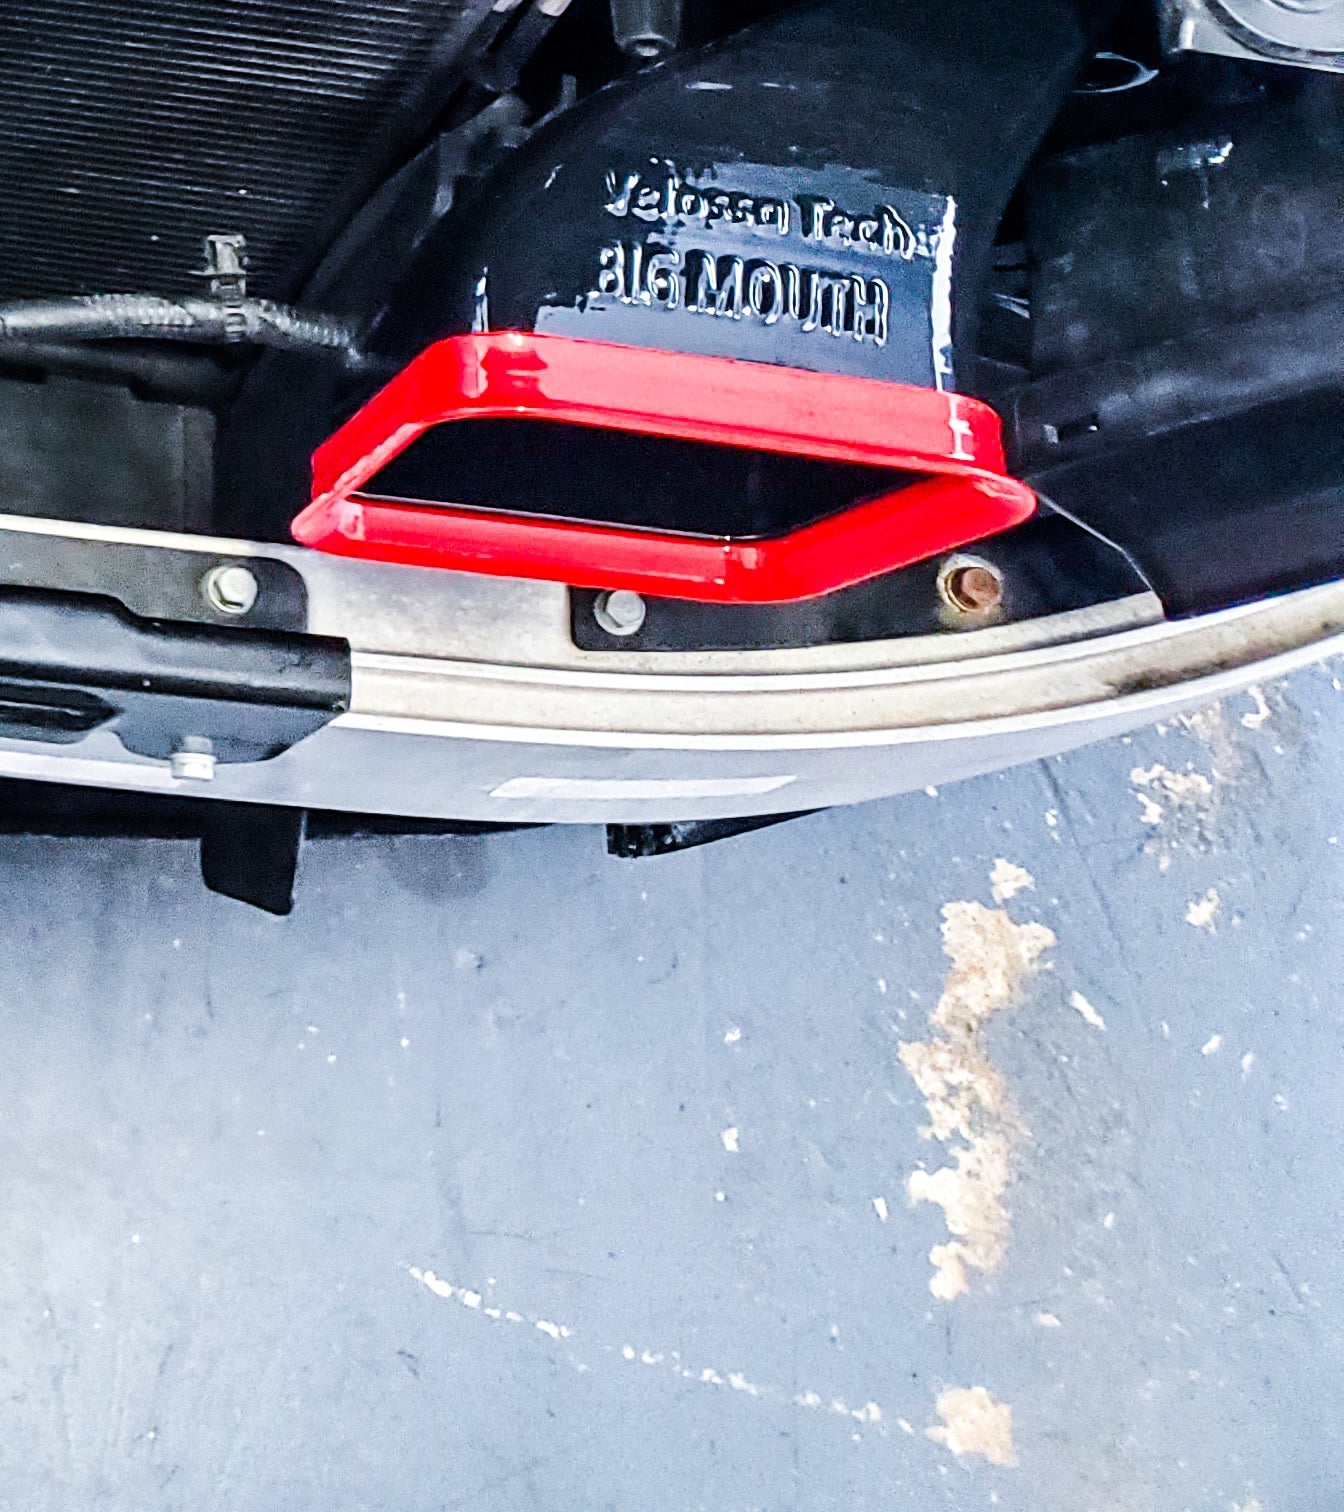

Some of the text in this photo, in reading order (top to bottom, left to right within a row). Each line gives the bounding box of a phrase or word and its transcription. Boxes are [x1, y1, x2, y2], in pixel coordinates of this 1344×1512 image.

[603, 164, 916, 261] Velossa Tech
[597, 240, 891, 348] BIG MOUTH
